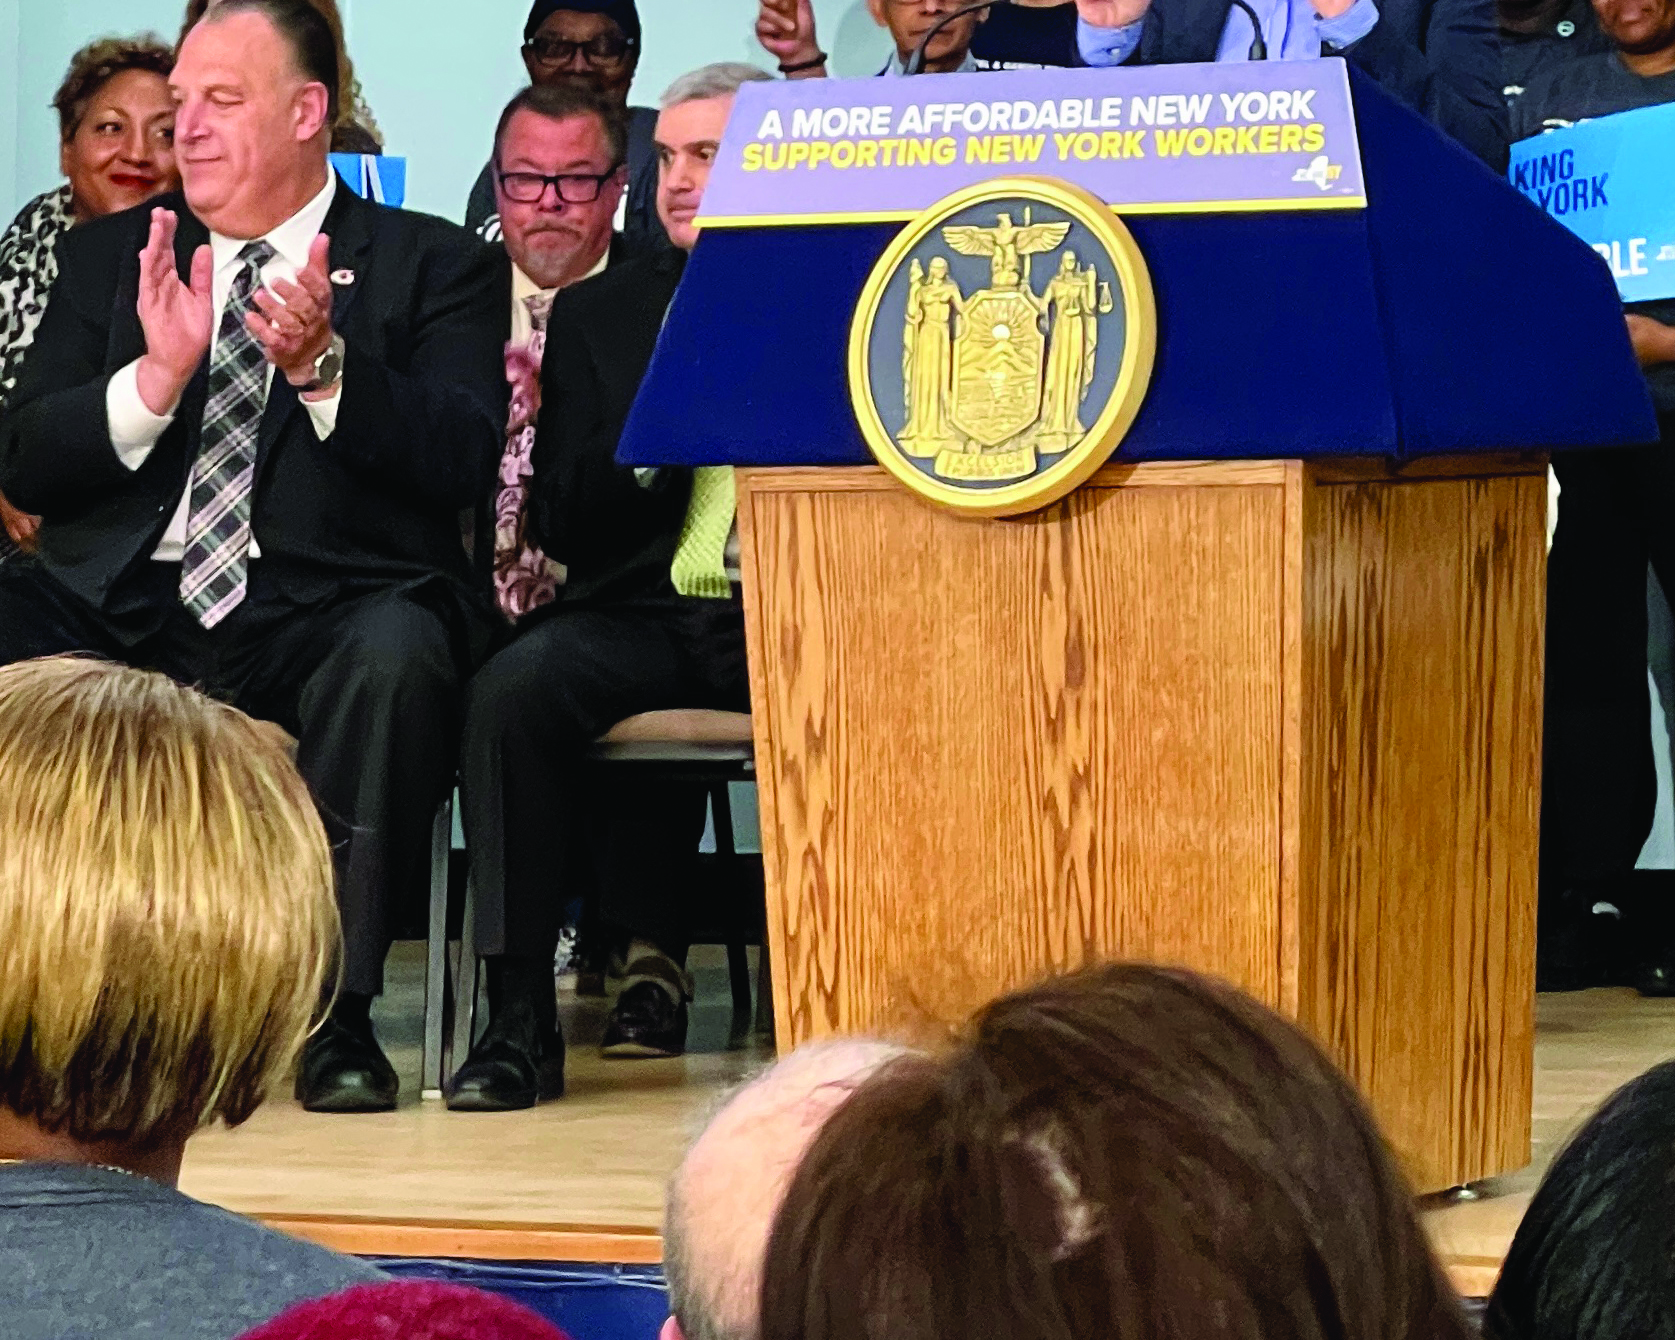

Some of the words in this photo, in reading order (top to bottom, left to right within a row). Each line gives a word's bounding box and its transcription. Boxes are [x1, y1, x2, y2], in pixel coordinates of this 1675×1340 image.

[756, 111, 785, 140] A
[792, 105, 891, 138] MORE
[898, 97, 1123, 133] AFFORDABLE
[1129, 93, 1214, 127] NEW
[1219, 90, 1317, 122] YORK
[741, 133, 959, 172] SUPPORTING
[964, 132, 1046, 164] NEW
[1053, 129, 1147, 160] YORK
[1154, 123, 1326, 157] WORKERS
